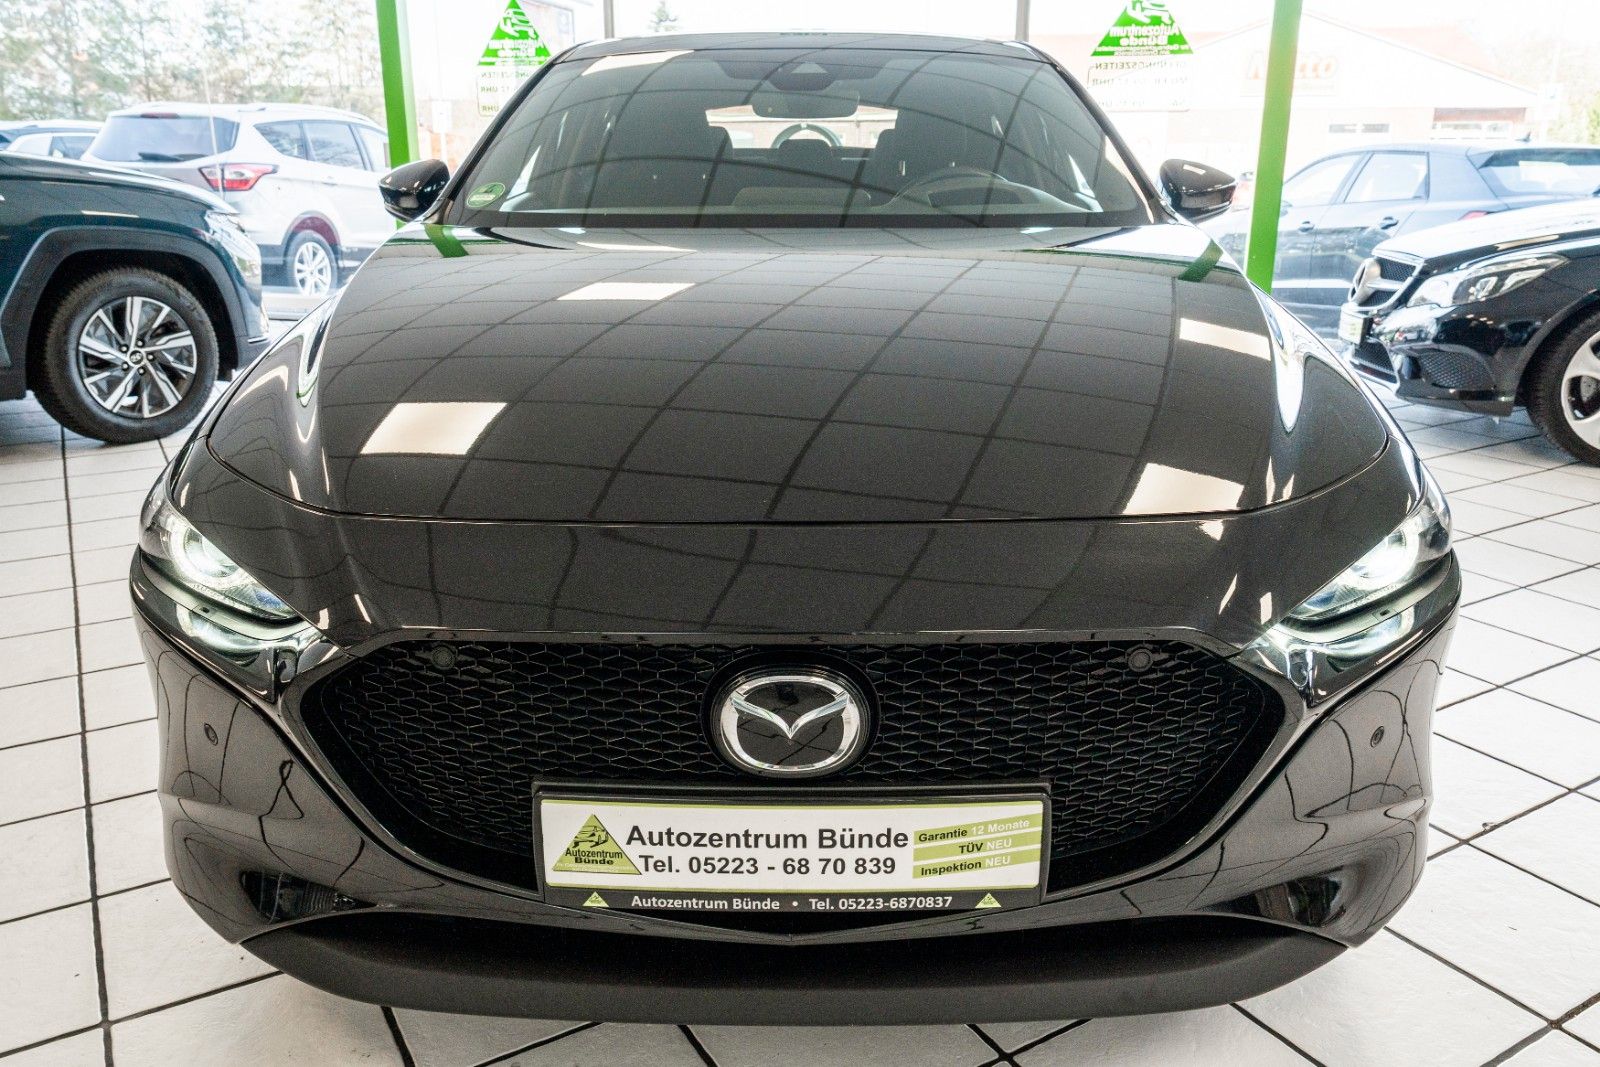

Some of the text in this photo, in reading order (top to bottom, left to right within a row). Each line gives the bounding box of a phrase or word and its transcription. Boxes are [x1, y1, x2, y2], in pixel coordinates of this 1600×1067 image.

[626, 825, 909, 849] Autozentrum Bünde
[918, 818, 1030, 842] Garantie 12 Monate
[565, 848, 623, 859] Autozentrum
[959, 839, 1012, 854] TÜV NEU
[574, 857, 614, 865] Bünde
[638, 854, 680, 873] Tel.
[688, 856, 759, 874] 05223
[783, 857, 810, 875] 68
[819, 857, 846, 875] 70
[854, 857, 896, 875] 839
[920, 855, 1011, 877] Inspektion NEU
[631, 895, 953, 910] Autozentrum Bünde Tel. 05223-6870837
